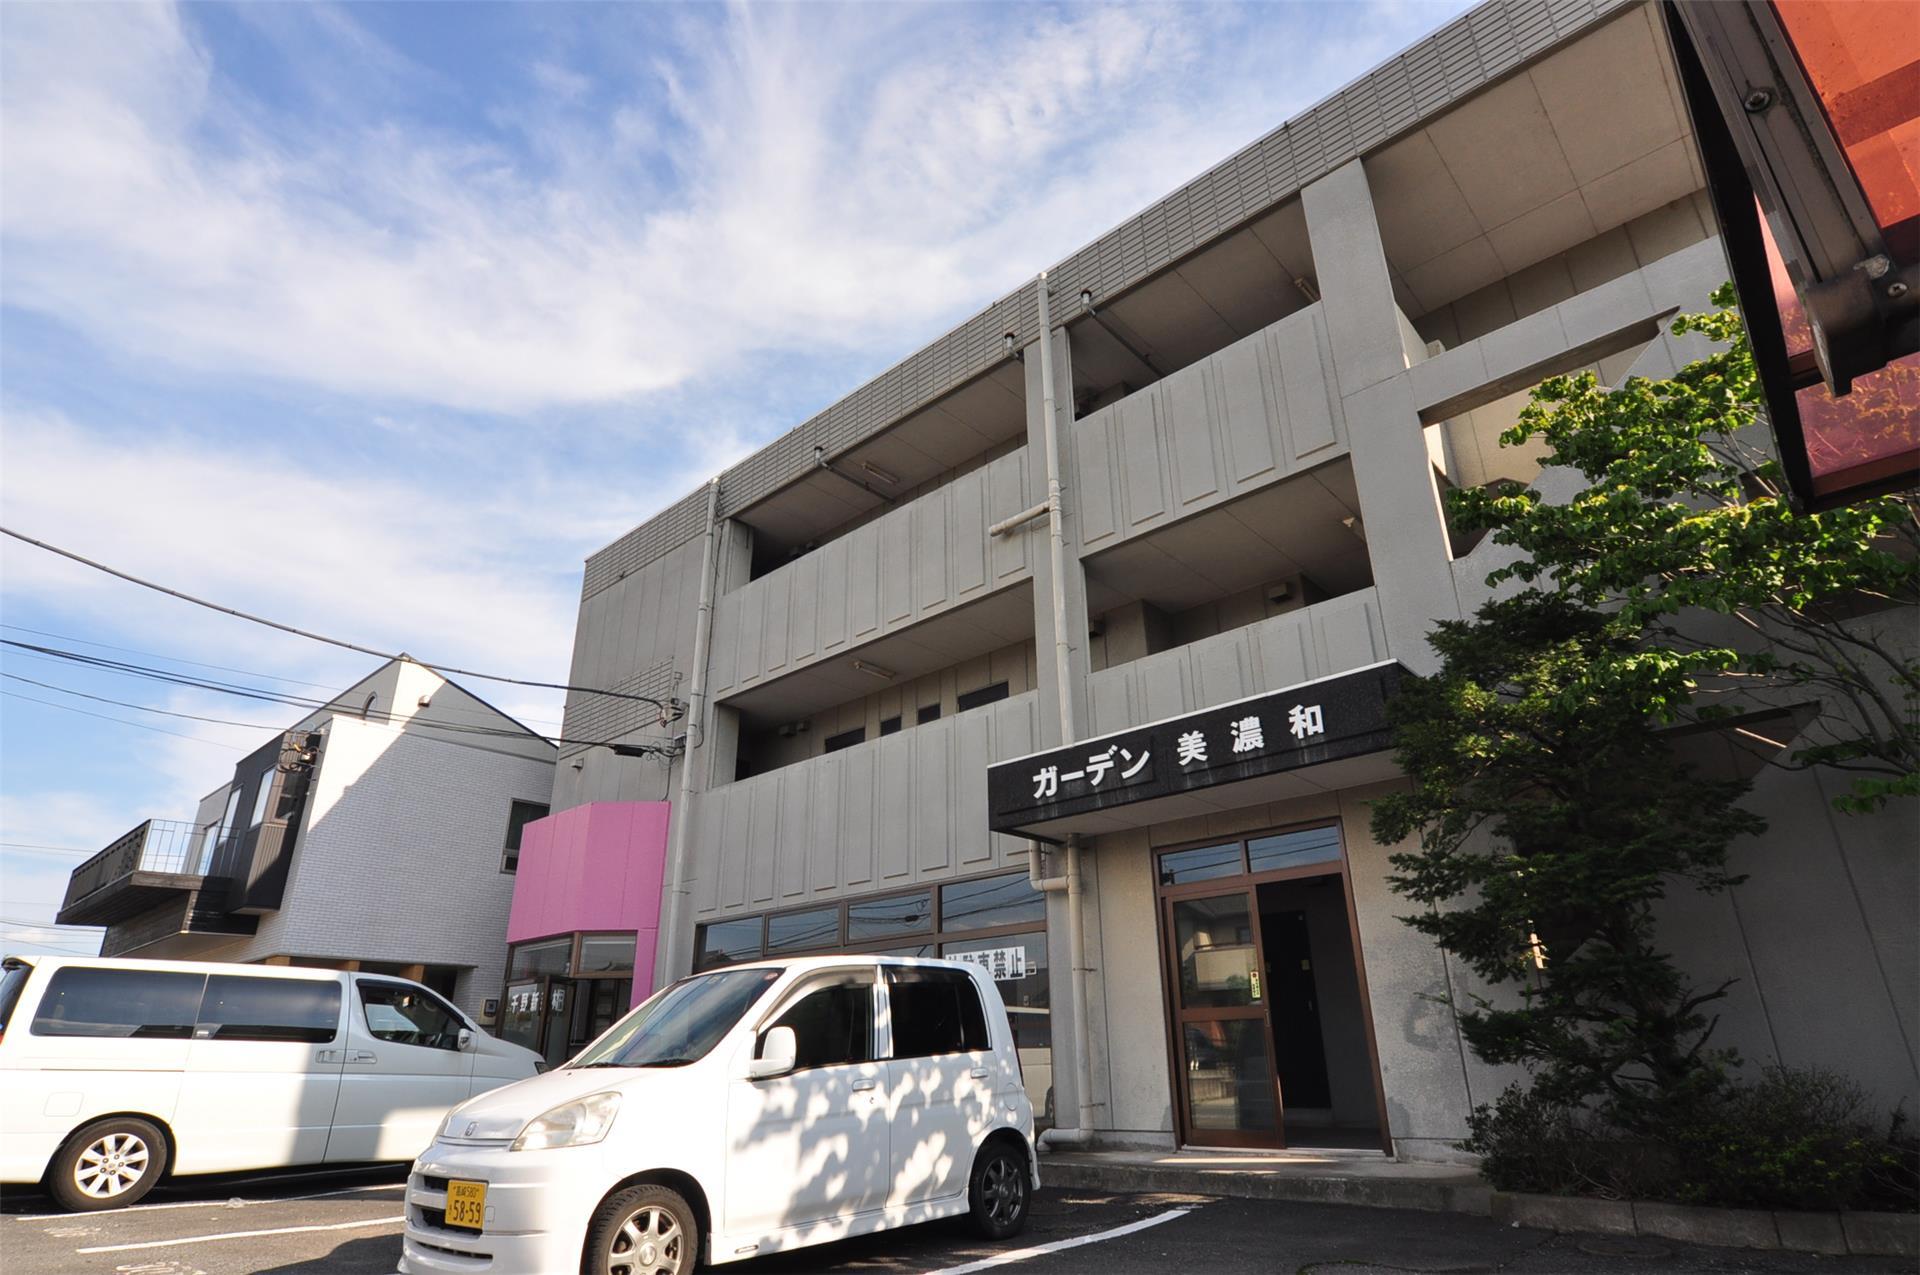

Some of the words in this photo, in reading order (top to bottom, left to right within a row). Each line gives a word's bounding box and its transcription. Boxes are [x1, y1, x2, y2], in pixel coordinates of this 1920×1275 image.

[1033, 744, 1150, 799] ガーデン
[1177, 704, 1325, 766] 美濃和
[948, 948, 1024, 979] 車禁止
